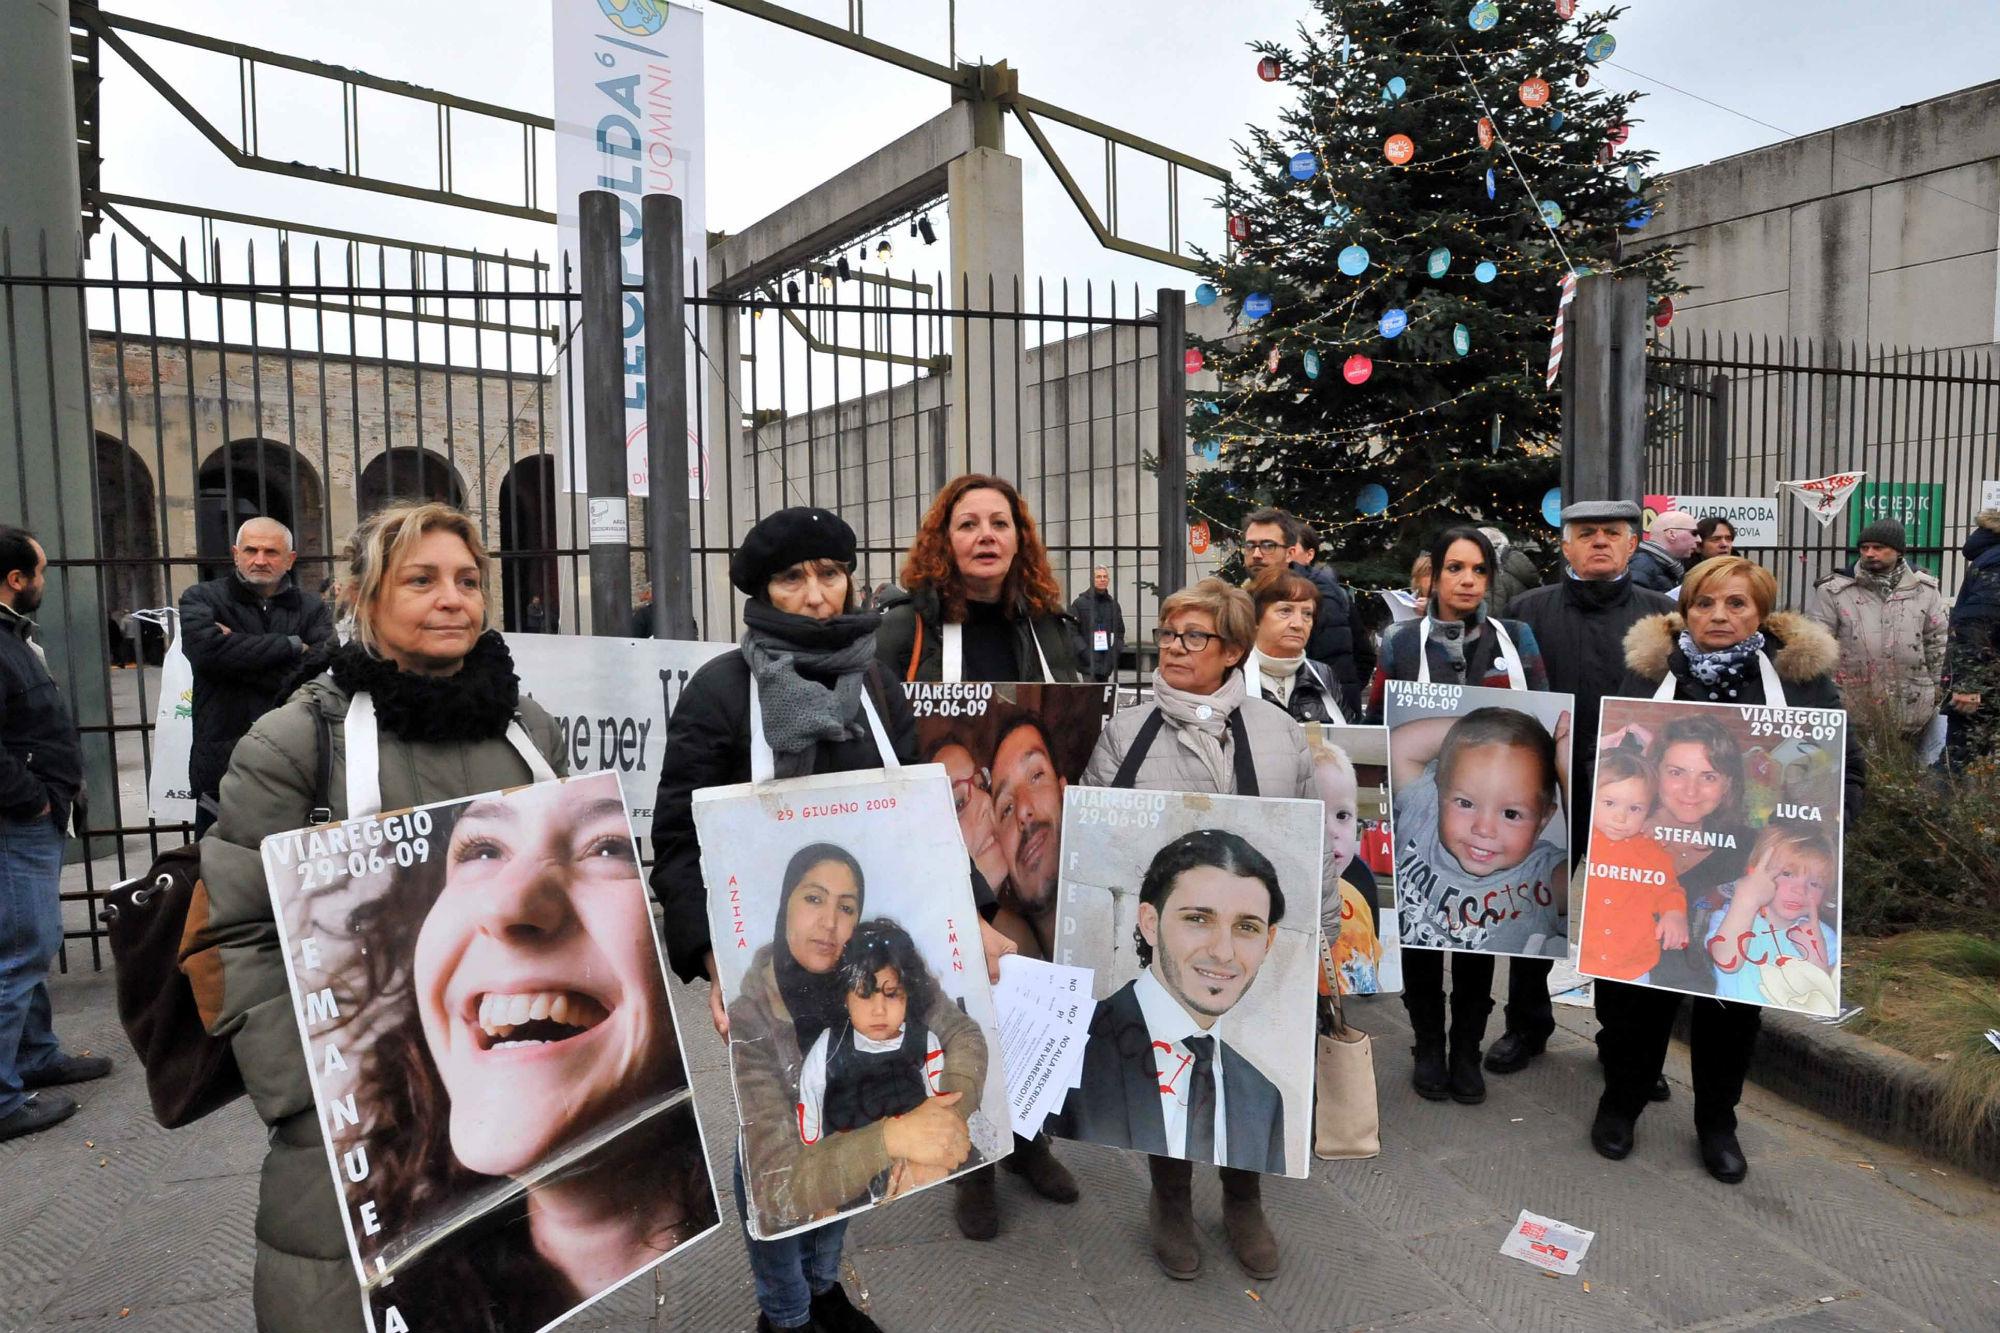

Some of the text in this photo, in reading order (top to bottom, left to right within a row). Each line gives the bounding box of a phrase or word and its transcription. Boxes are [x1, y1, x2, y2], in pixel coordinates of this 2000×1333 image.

[648, 64, 673, 193] UOMINI
[1678, 505, 1775, 521] GUARDAROBA
[903, 683, 993, 700] VIAREGGIO
[1389, 680, 1463, 698] VIAREGGIO
[913, 700, 988, 717] 29-06-09
[1396, 693, 1459, 711] 29-06-09
[1741, 707, 1842, 727] VIAREGGIO
[1751, 721, 1836, 741] 29-06-09
[598, 716, 651, 772] per
[777, 798, 897, 821] 29 GIUGNO 2009
[1069, 789, 1167, 812] VIAREGGIO
[1079, 807, 1160, 829] 29-06-09
[1379, 782, 1389, 855] LUCA
[1776, 803, 1822, 822] LUCA
[270, 810, 433, 865] VIAREGGIO
[1654, 826, 1737, 849] STEFANIA
[297, 837, 430, 890] 29-06-09
[1588, 862, 1667, 886] LORENZO
[728, 875, 748, 949] AZIZA
[947, 919, 963, 972] IMAN
[1068, 1004, 1079, 1018] NO
[1043, 1037, 1056, 1054] PER
[1018, 1035, 1071, 1121] NO ALLA PRESCRIZIONE
[300, 937, 409, 1333] EMANUELA
